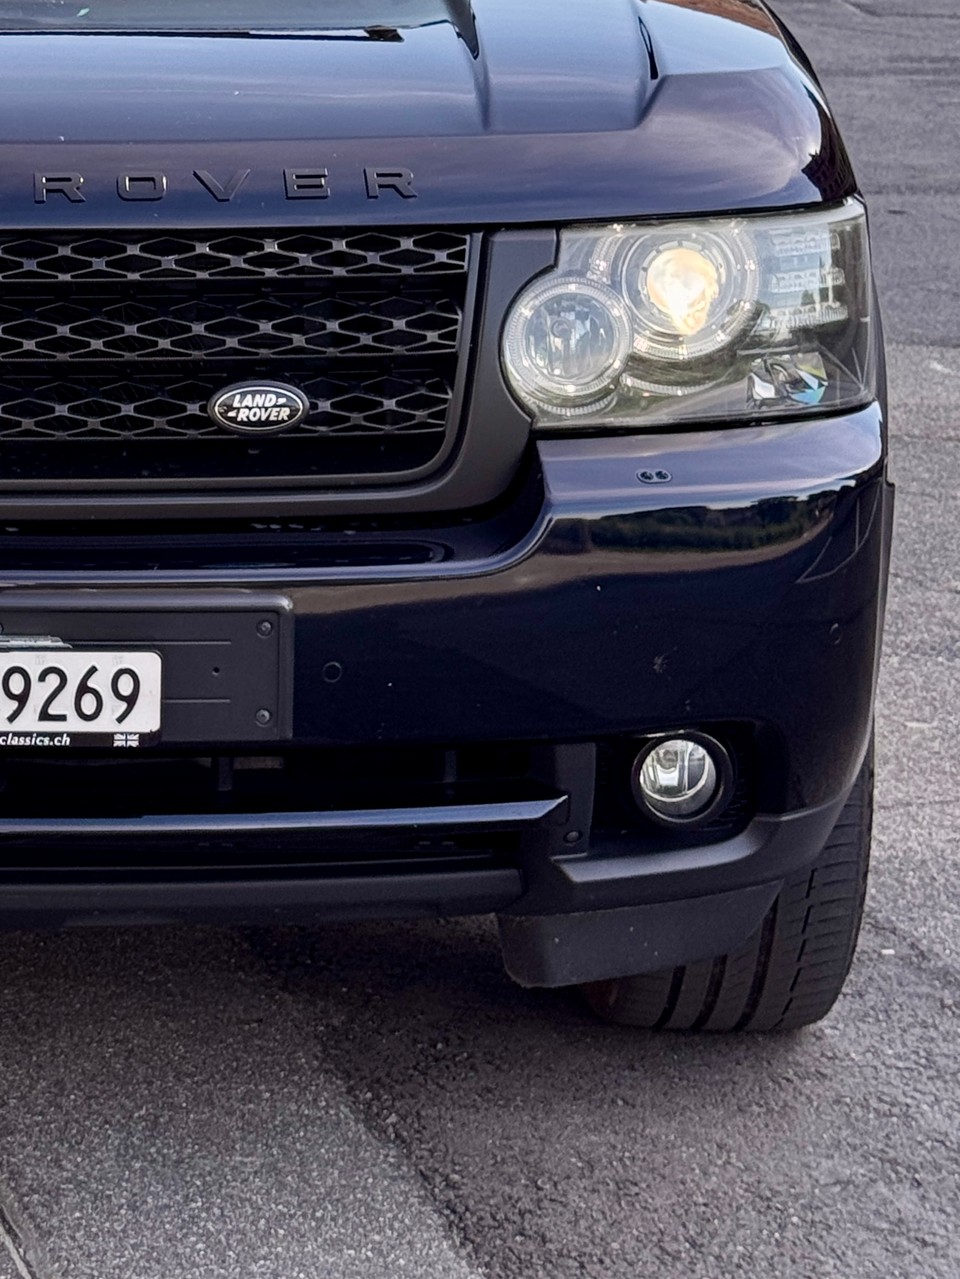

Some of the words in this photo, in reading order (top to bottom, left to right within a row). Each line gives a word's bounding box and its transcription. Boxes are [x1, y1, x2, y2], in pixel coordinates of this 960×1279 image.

[33, 166, 419, 204] ROVER
[233, 393, 277, 408] LAND
[236, 407, 291, 422] ROVER
